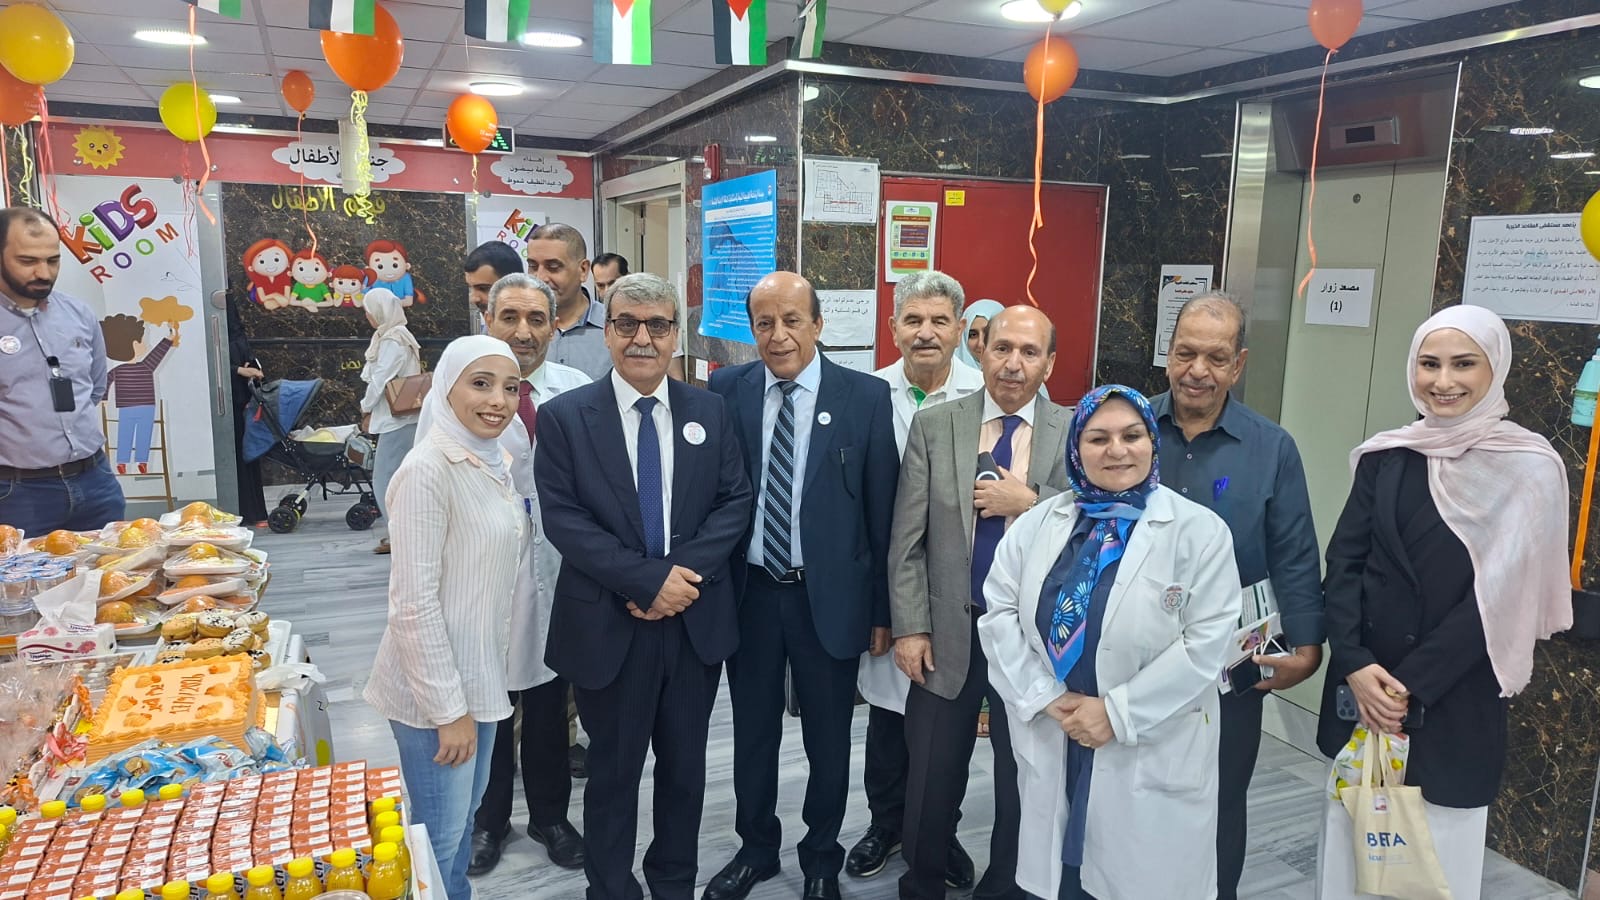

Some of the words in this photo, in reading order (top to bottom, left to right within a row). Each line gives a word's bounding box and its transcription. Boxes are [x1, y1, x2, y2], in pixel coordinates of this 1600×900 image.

[289, 145, 339, 165] لأطفال
[90, 222, 180, 284] ROOM
[1320, 281, 1338, 293] زوار
[1339, 284, 1360, 292] مصعد
[1330, 300, 1343, 313] (1)
[1366, 831, 1407, 847] BETA
